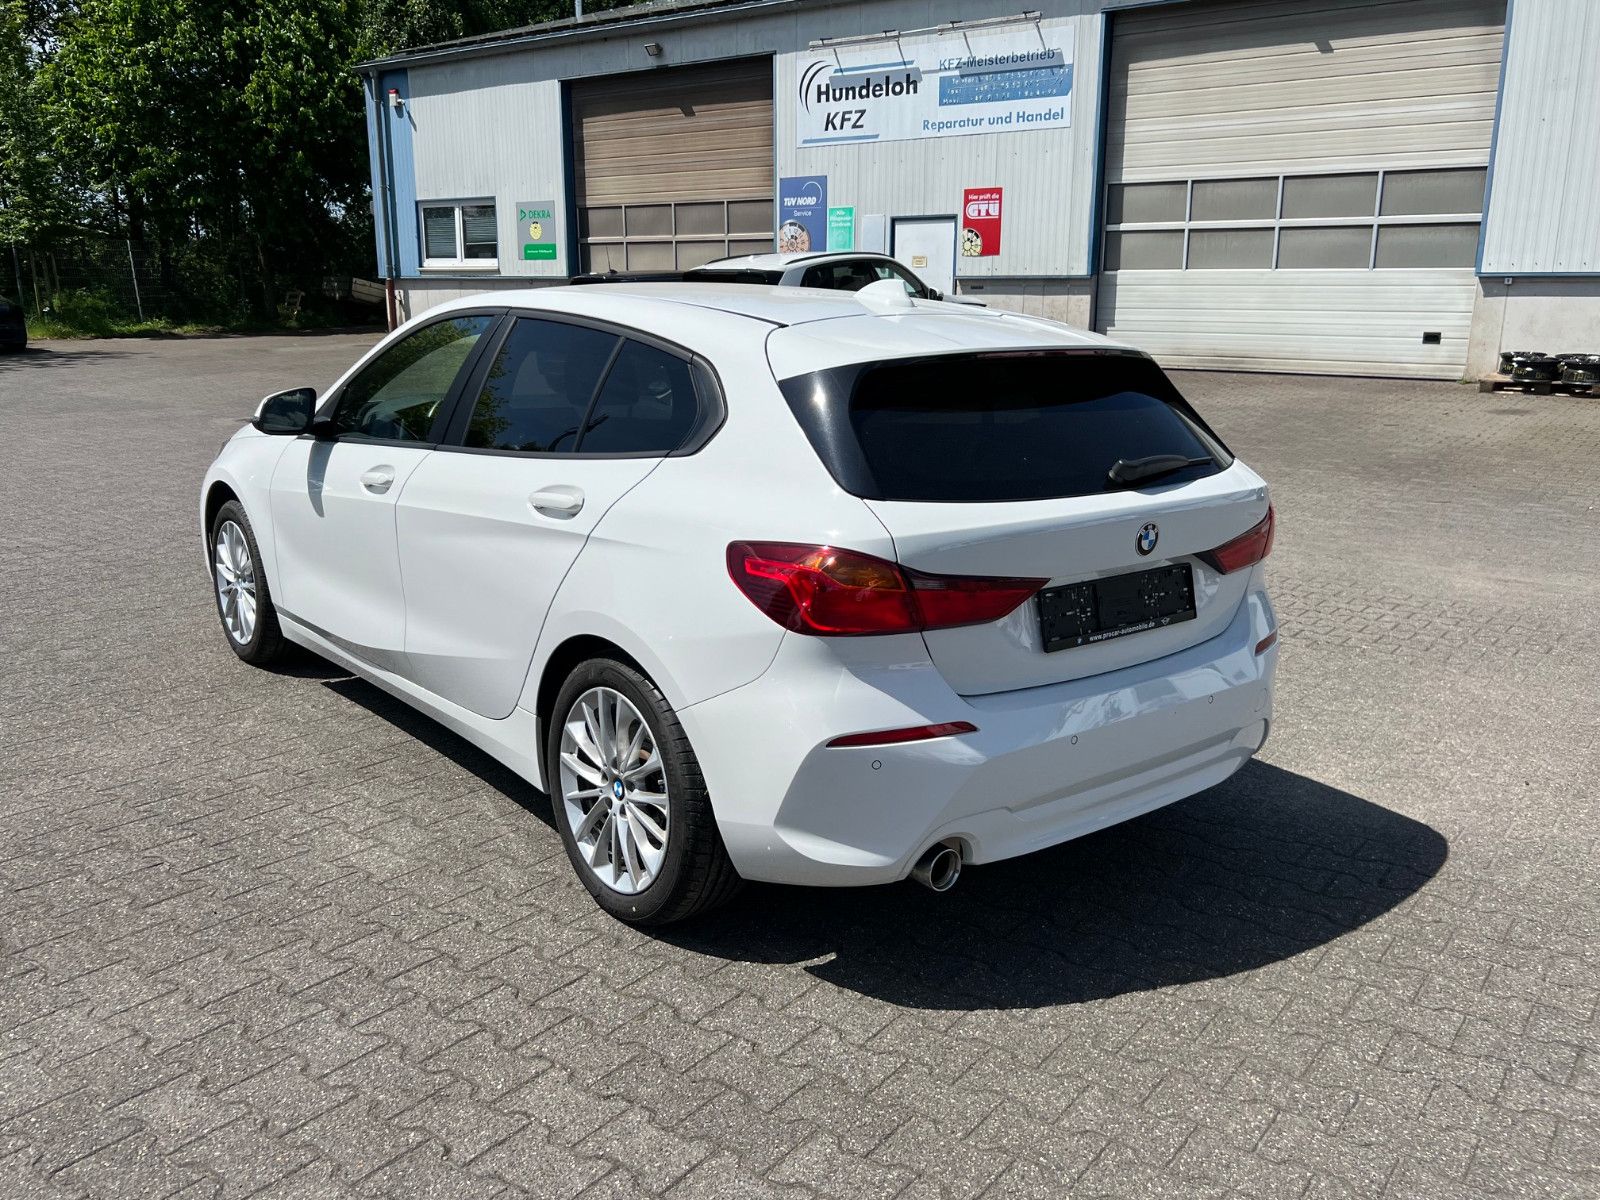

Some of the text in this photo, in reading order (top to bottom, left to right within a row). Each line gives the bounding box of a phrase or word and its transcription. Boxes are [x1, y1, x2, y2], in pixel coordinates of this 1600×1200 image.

[939, 48, 1055, 71] KFZ-Meisterbetrieb
[816, 73, 917, 104] Hundeloh
[824, 109, 867, 132] KFZ
[922, 107, 1064, 133] Reparatur und Handel
[796, 195, 817, 206] NORD
[528, 209, 551, 219] DEKRA
[793, 209, 812, 217] Service
[1089, 621, 1155, 641] www.procar-automobile.de
